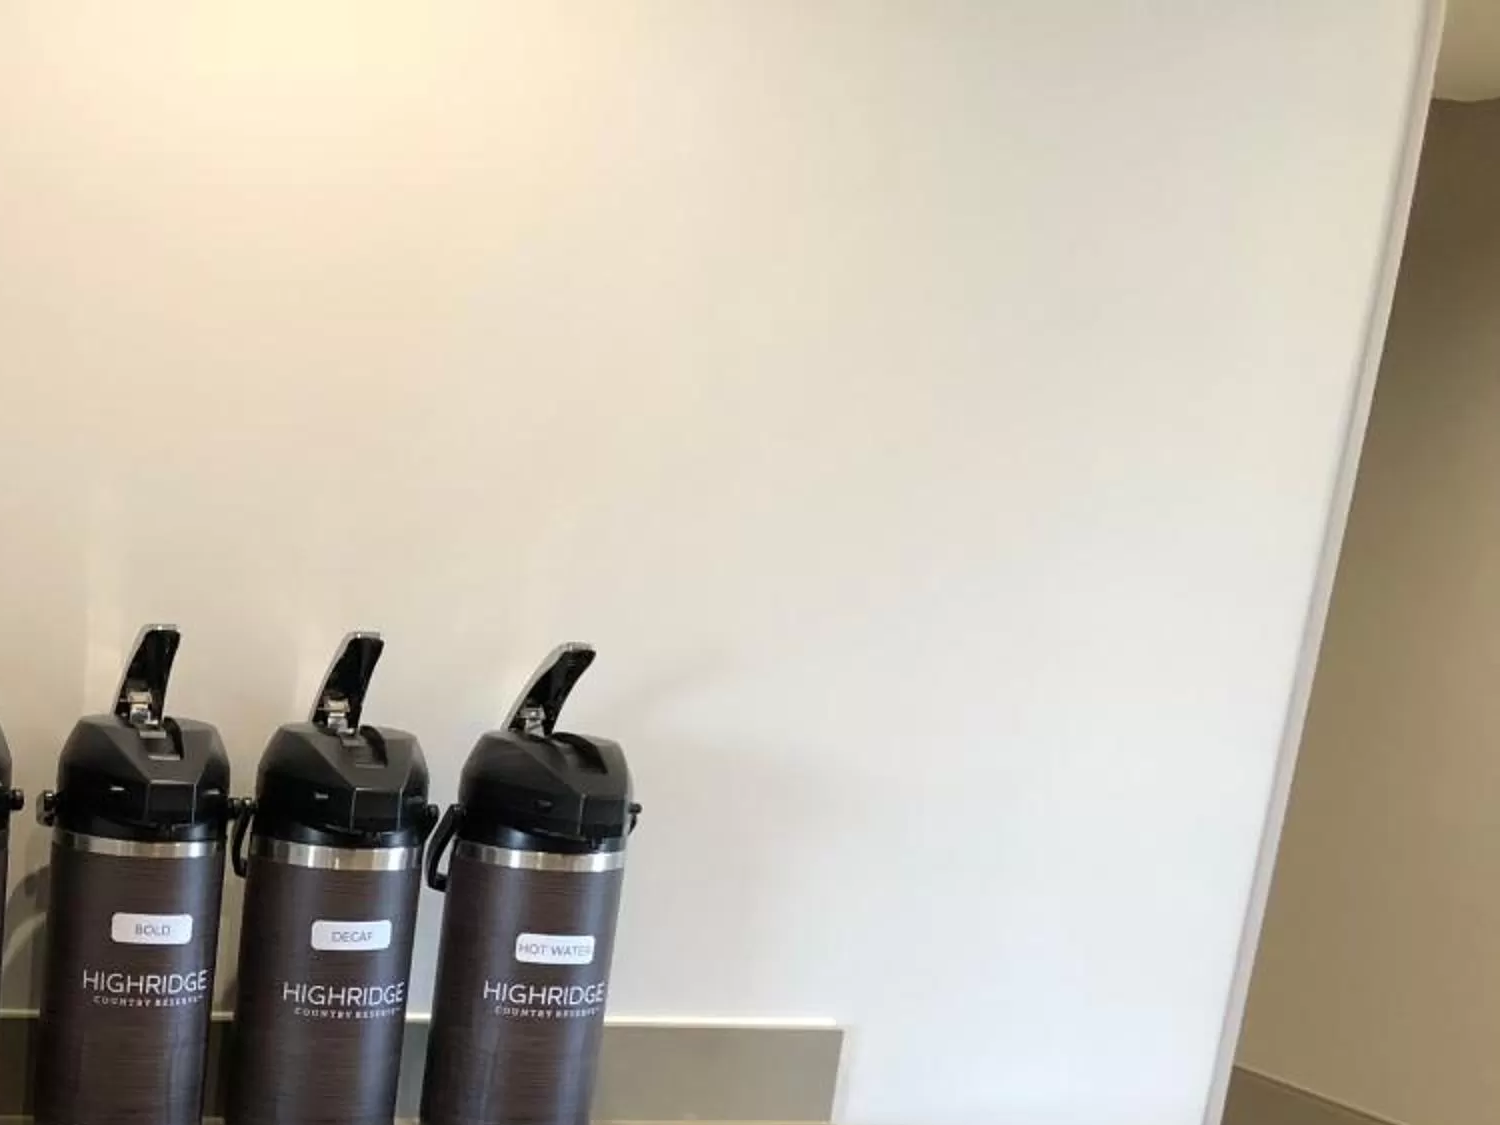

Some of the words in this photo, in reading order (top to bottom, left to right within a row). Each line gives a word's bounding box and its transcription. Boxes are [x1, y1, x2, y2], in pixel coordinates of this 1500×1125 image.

[135, 923, 170, 936] BOLD
[331, 930, 372, 943] DECAF
[519, 943, 548, 956] HOT
[83, 969, 207, 994] HIGHRIDGE
[283, 981, 404, 1006] HIGHRIDGE
[483, 980, 604, 1005] HIGHRIDGE
